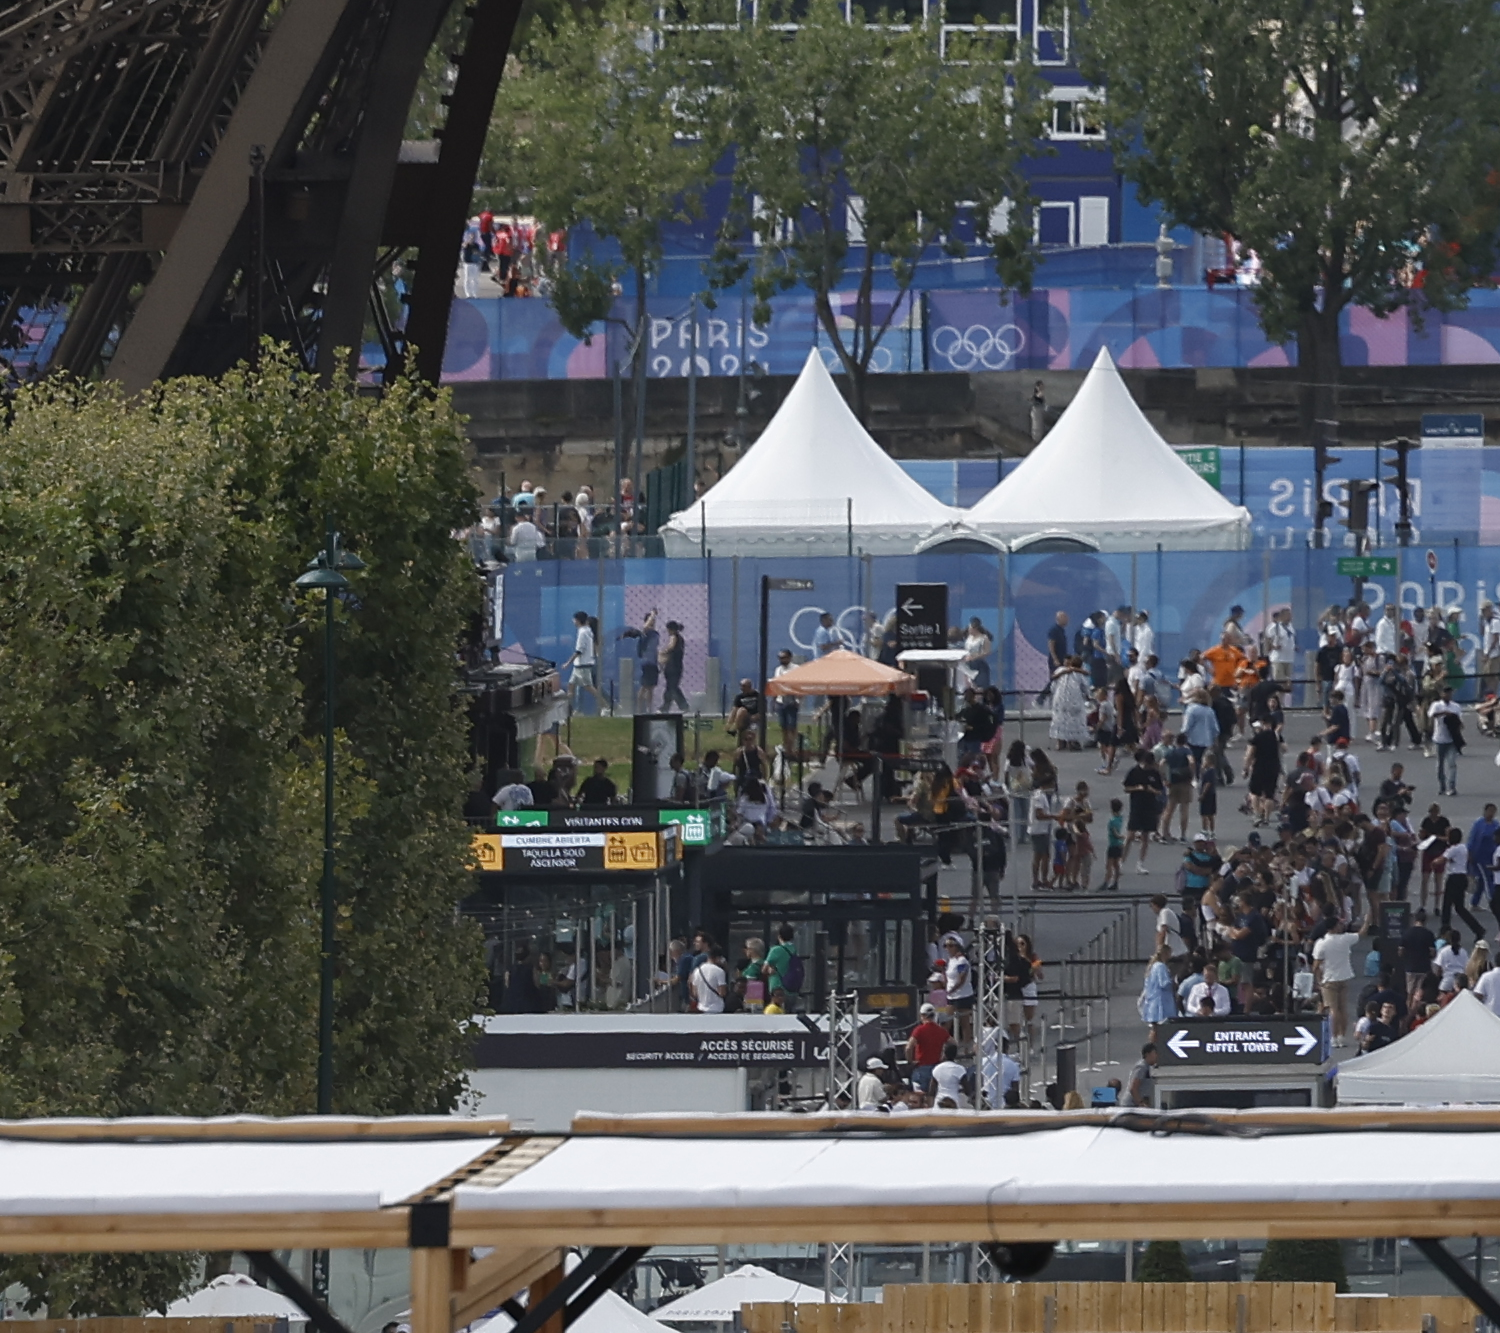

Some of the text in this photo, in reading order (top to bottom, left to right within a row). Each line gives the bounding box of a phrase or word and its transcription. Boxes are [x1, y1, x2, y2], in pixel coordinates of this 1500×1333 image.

[900, 623, 934, 635] Sortie
[522, 849, 561, 859] TAQUILLA
[1214, 1031, 1271, 1042] ENTRANCE
[1206, 1042, 1279, 1052] EIFFEL TOWER
